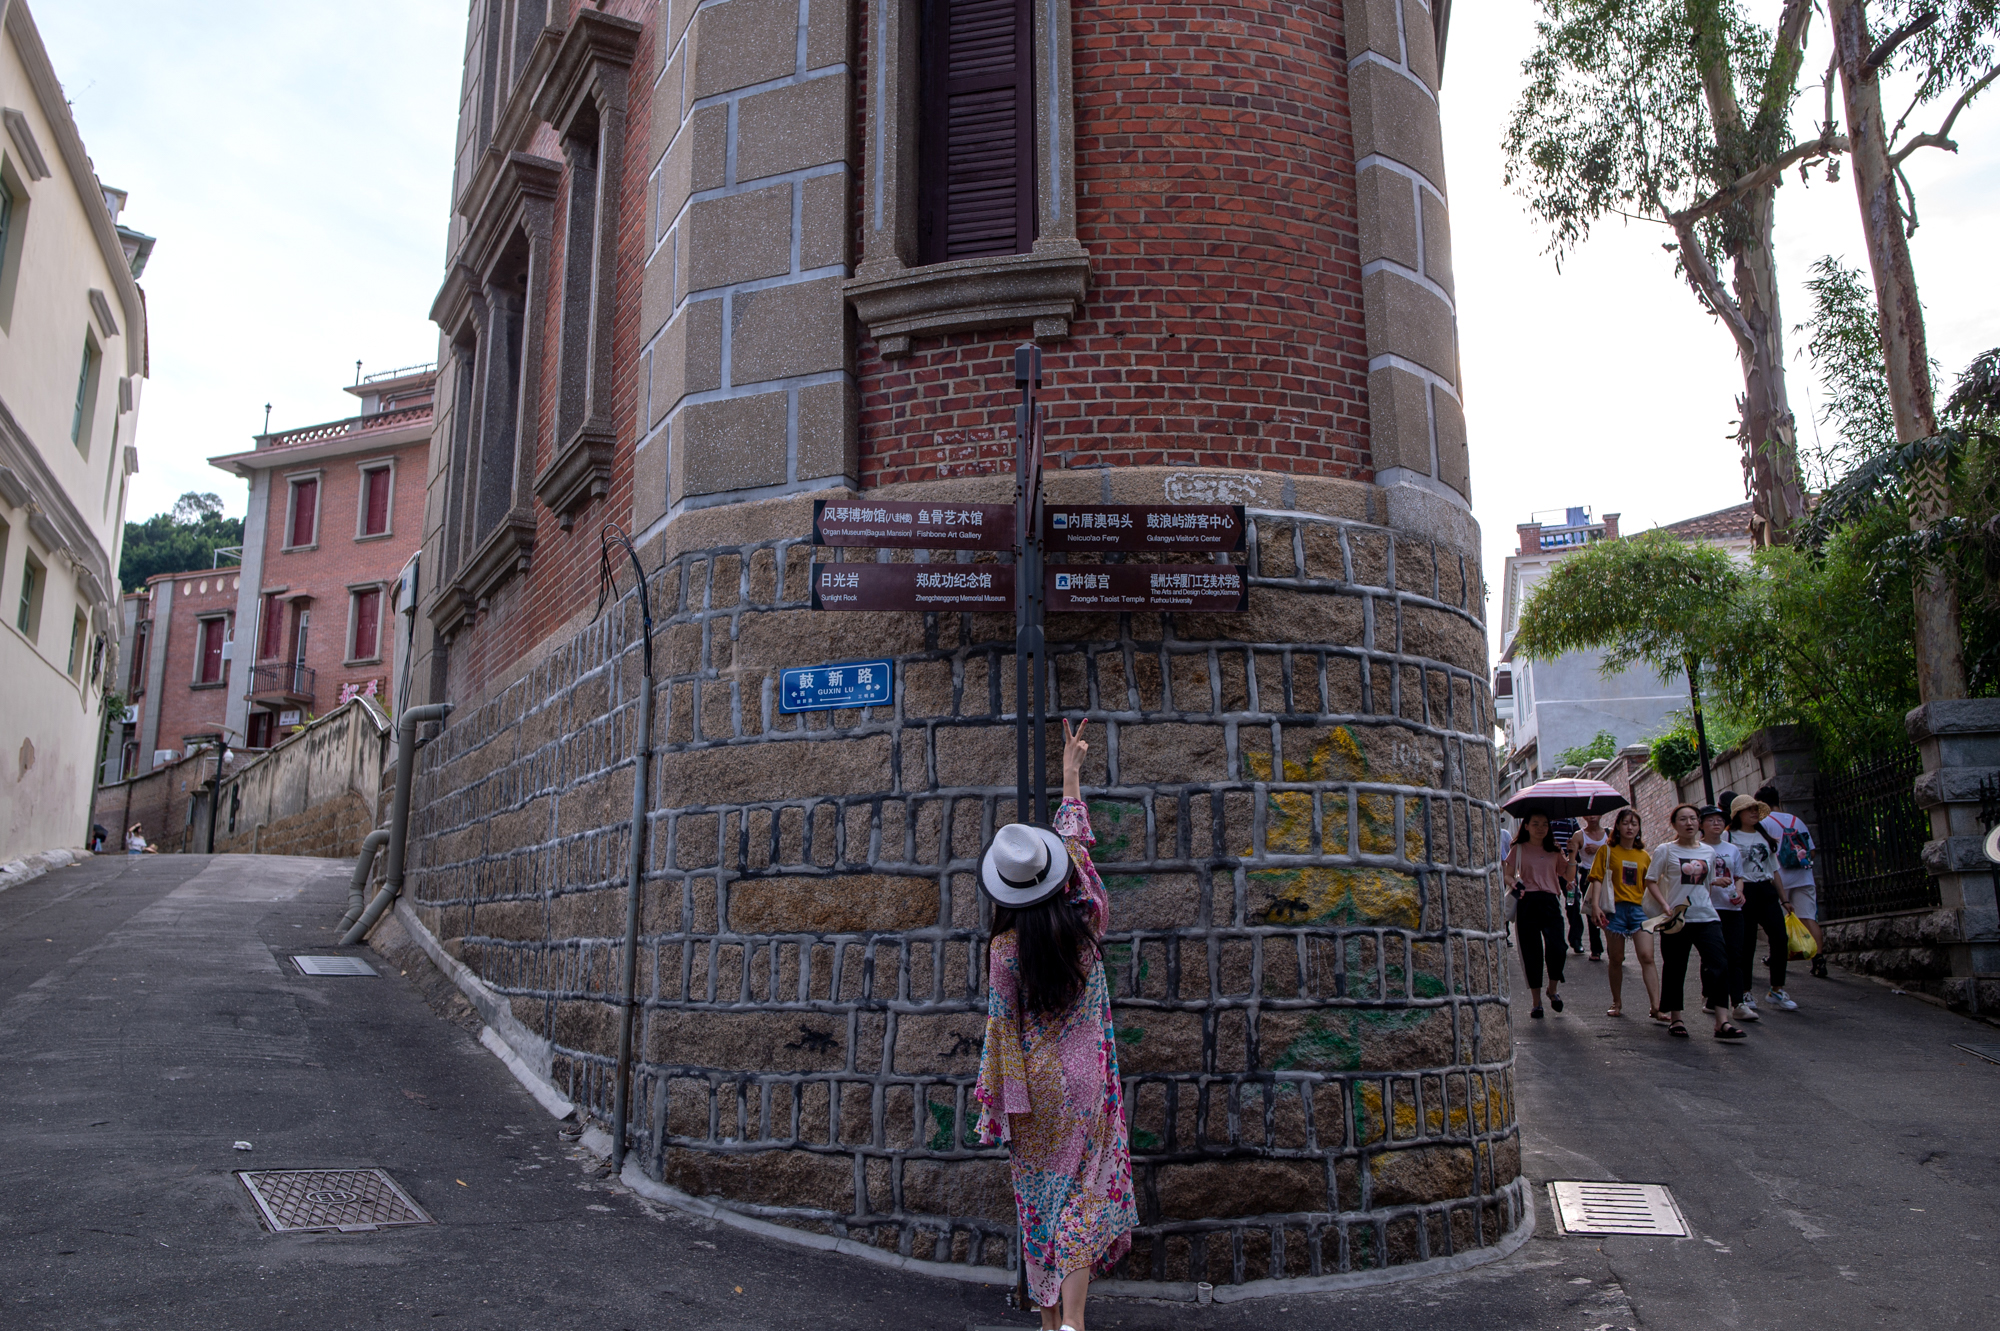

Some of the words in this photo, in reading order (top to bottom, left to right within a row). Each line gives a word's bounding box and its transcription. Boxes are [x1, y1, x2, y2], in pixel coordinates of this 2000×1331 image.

[917, 509, 983, 525] 鱼骨艺术馆
[1068, 513, 1133, 528] 内厝澳码头
[1147, 514, 1234, 529] 鼓浪屿游客中心
[886, 530, 912, 538] Mansion)
[959, 532, 982, 540] Gallery
[1102, 535, 1120, 543] Ferry
[1147, 535, 1175, 543] Gulangyu
[822, 572, 859, 588] 日光岩
[916, 573, 992, 588] 郑成功纪念馆
[1071, 574, 1110, 589] 种德宫
[1150, 574, 1240, 588] 福州大学厦门工艺美术学院
[799, 668, 873, 689] 鼓新路
